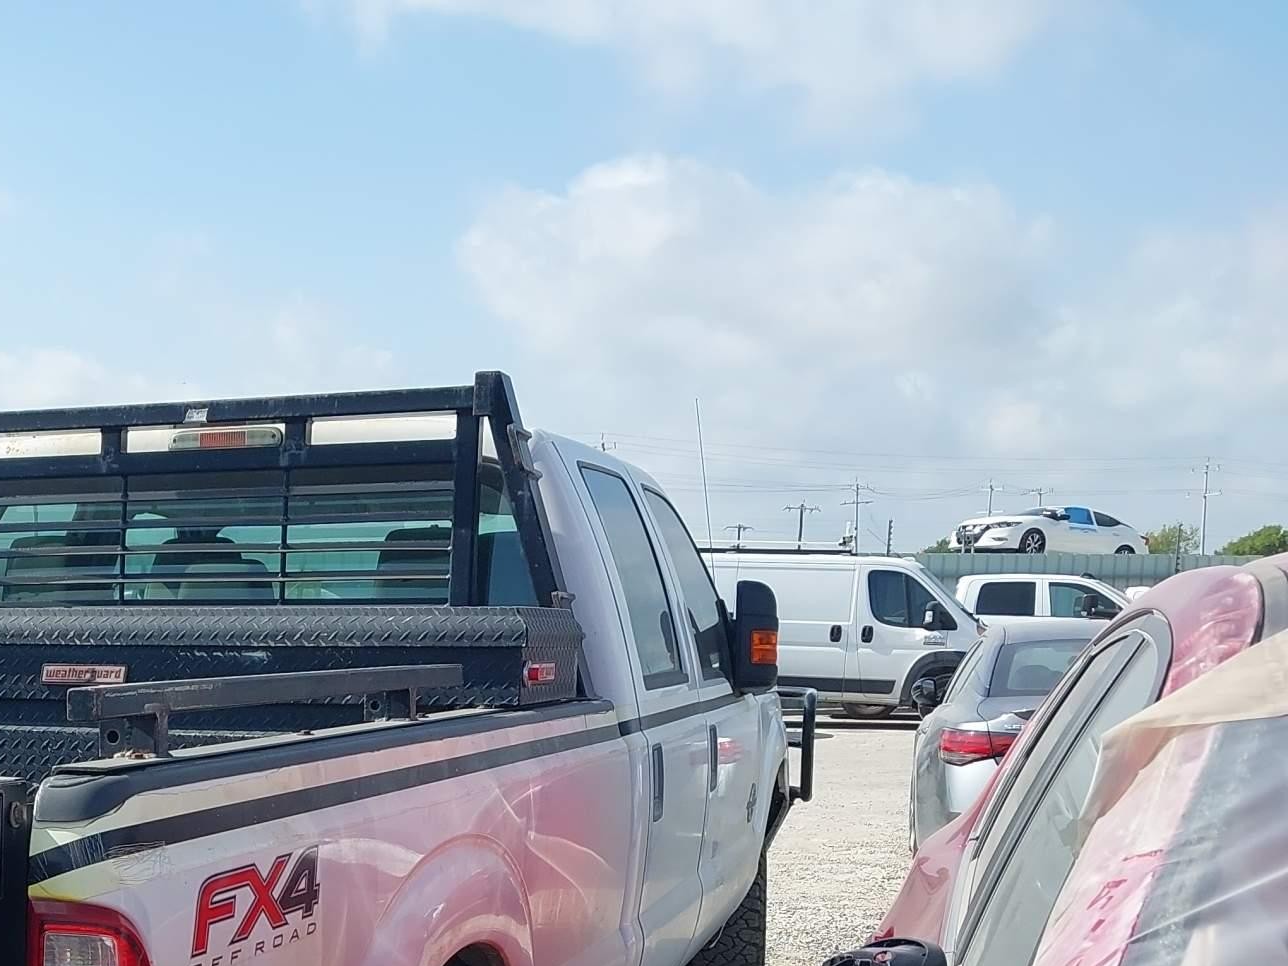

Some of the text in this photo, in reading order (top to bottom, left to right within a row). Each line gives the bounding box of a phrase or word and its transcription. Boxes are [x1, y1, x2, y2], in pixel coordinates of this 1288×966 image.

[46, 667, 89, 680] weather
[190, 845, 320, 959] FX4
[254, 922, 317, 957] ROAD
